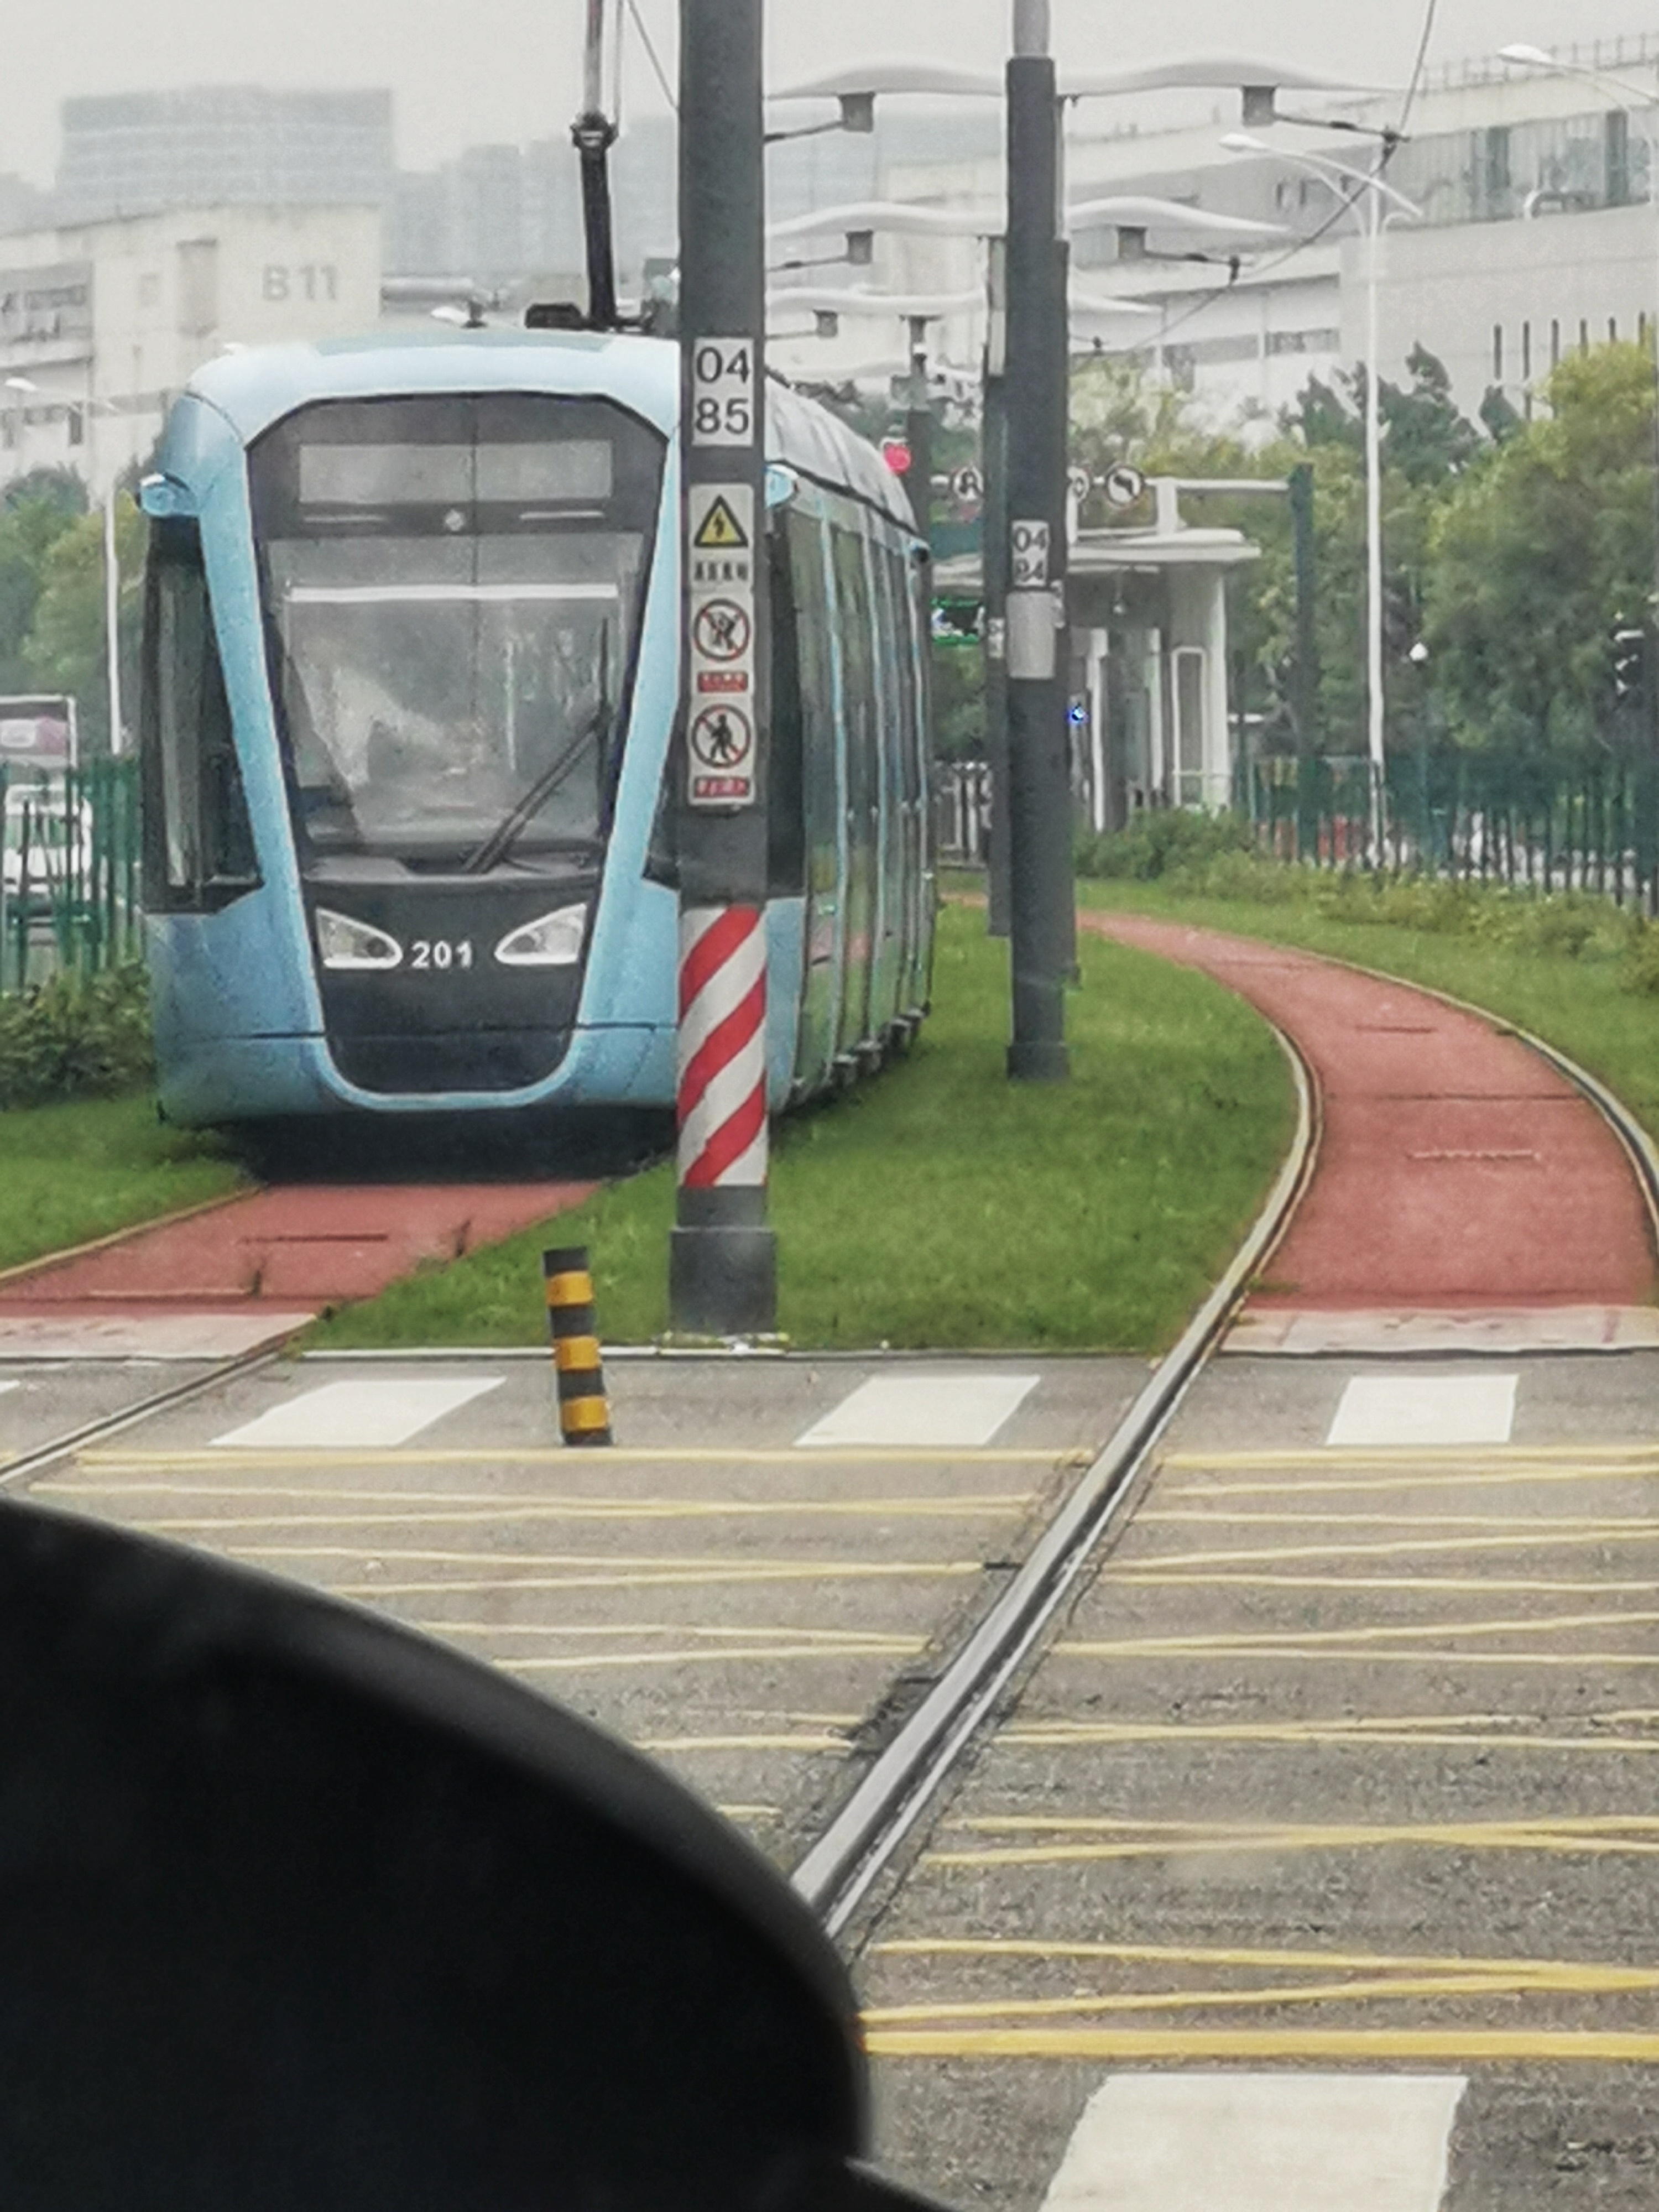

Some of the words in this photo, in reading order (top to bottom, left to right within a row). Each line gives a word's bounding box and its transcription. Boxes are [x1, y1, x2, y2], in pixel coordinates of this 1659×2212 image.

[262, 264, 337, 301] B11
[696, 347, 750, 384] 04
[695, 397, 749, 434] 85
[1014, 527, 1048, 552] 04
[411, 941, 473, 969] 201
